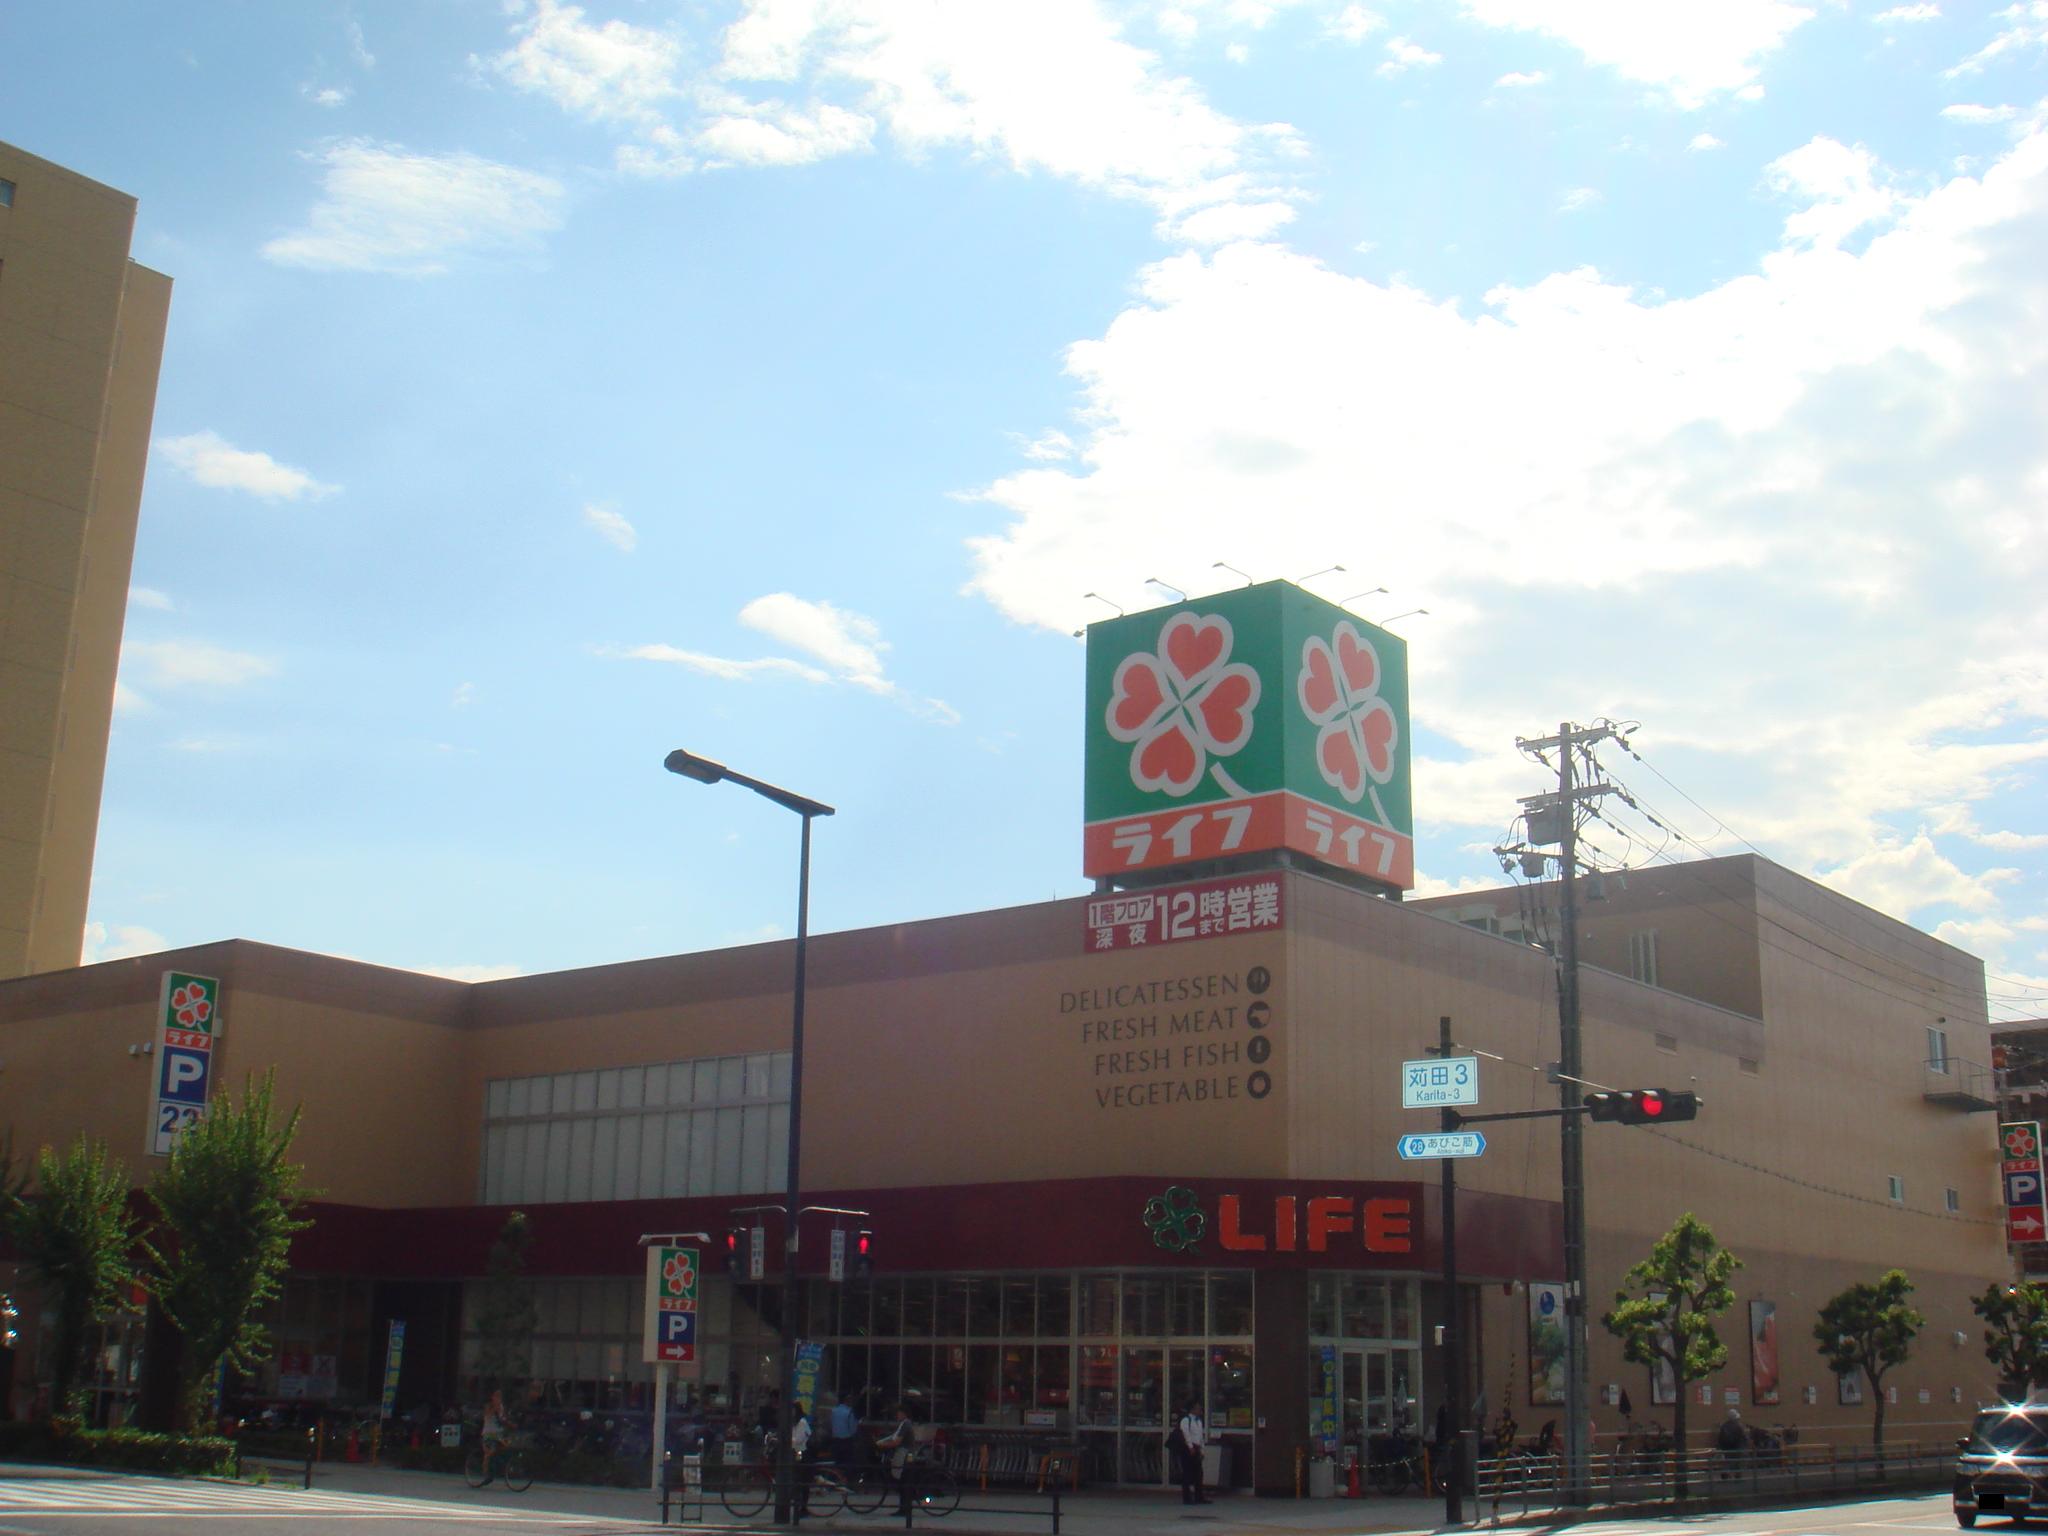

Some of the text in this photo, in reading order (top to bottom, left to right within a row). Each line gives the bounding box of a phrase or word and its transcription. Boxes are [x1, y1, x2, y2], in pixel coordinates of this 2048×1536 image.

[1112, 806, 1252, 865] ライフ
[1306, 808, 1395, 875] ライフ
[1060, 973, 1239, 1014] DELICATESSEN
[166, 1031, 209, 1048] ライフ
[1082, 1007, 1238, 1044] FRESH MEAT
[167, 1053, 204, 1093] P
[1094, 1041, 1239, 1076] FRESH FISH
[1095, 1076, 1239, 1109] VEGETABLE
[1416, 1089, 1460, 1101] Karita-3
[2011, 1176, 2037, 1202] P
[1218, 1194, 1411, 1252] LIFE
[663, 1298, 692, 1310] ライフ
[669, 1315, 688, 1340] P
